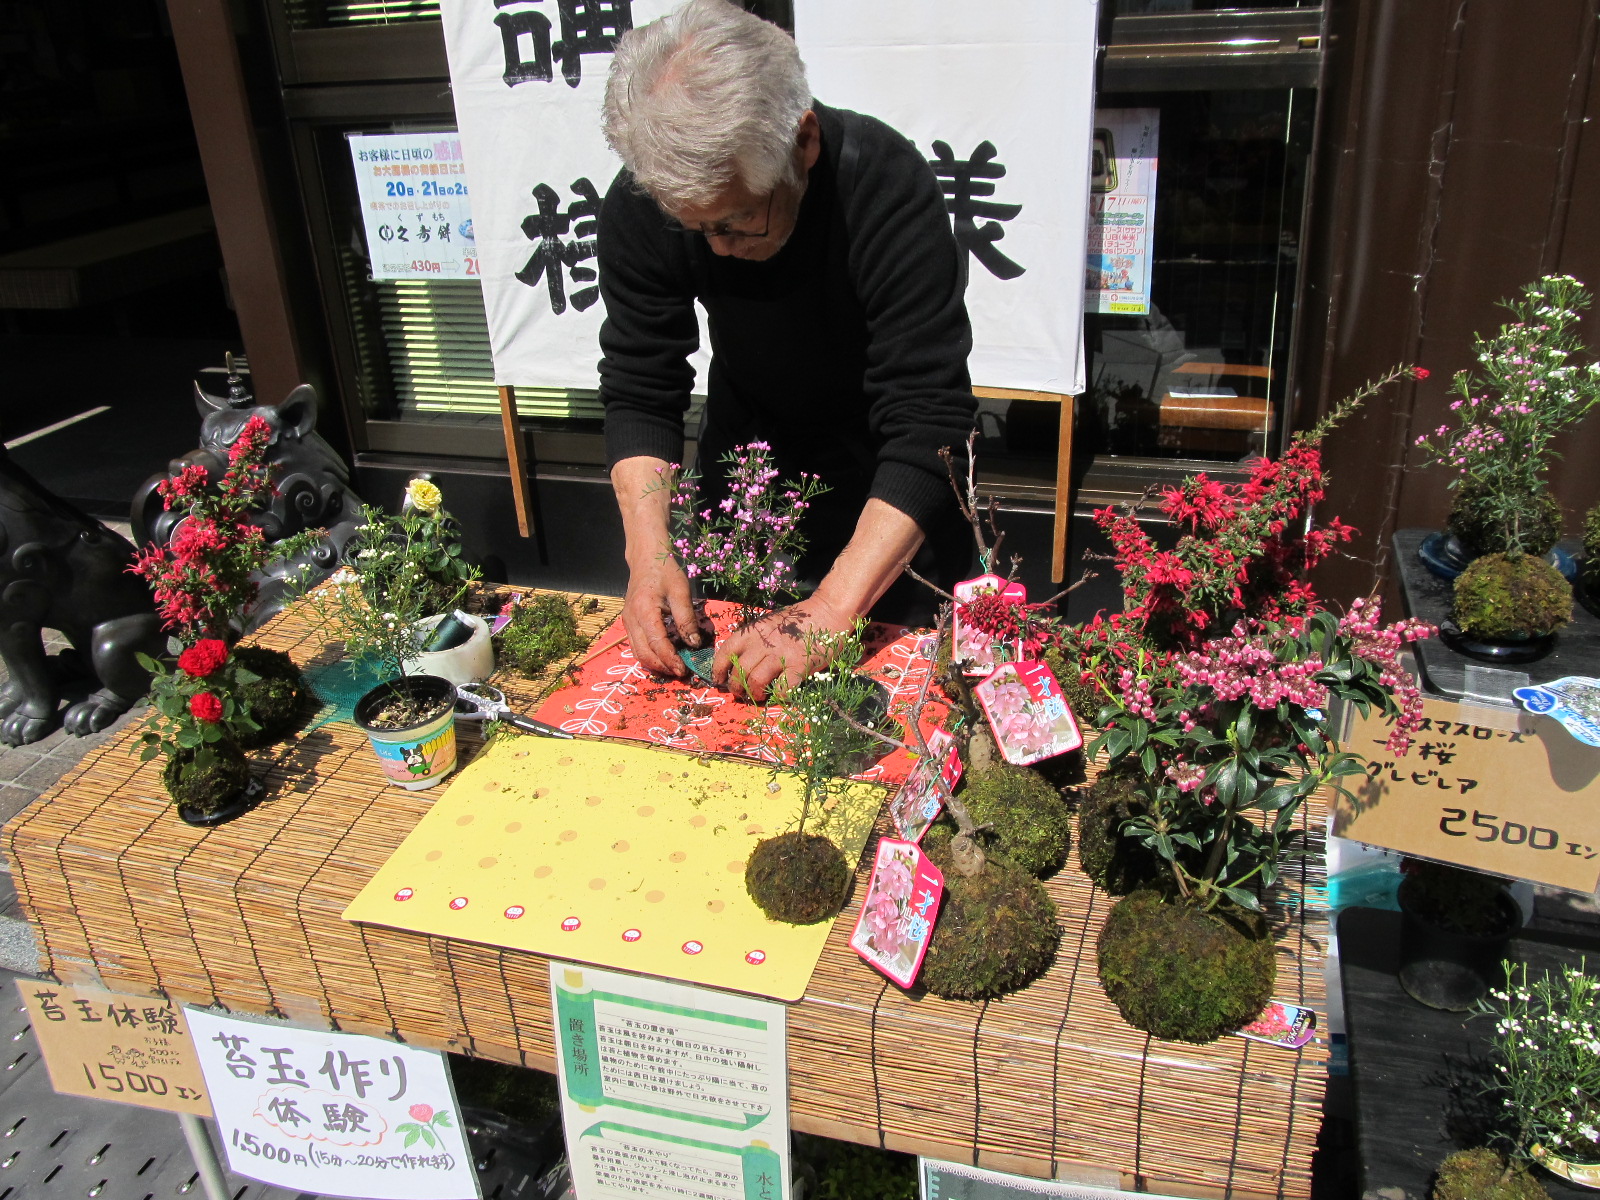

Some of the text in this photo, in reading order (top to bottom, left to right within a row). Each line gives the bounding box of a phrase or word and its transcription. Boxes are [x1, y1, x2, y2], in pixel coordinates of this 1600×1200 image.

[33, 988, 183, 1035] 苔玉体験
[211, 1031, 408, 1101] 苔玉作り
[568, 1017, 589, 1077] 置き場所
[268, 1096, 371, 1134] 体験
